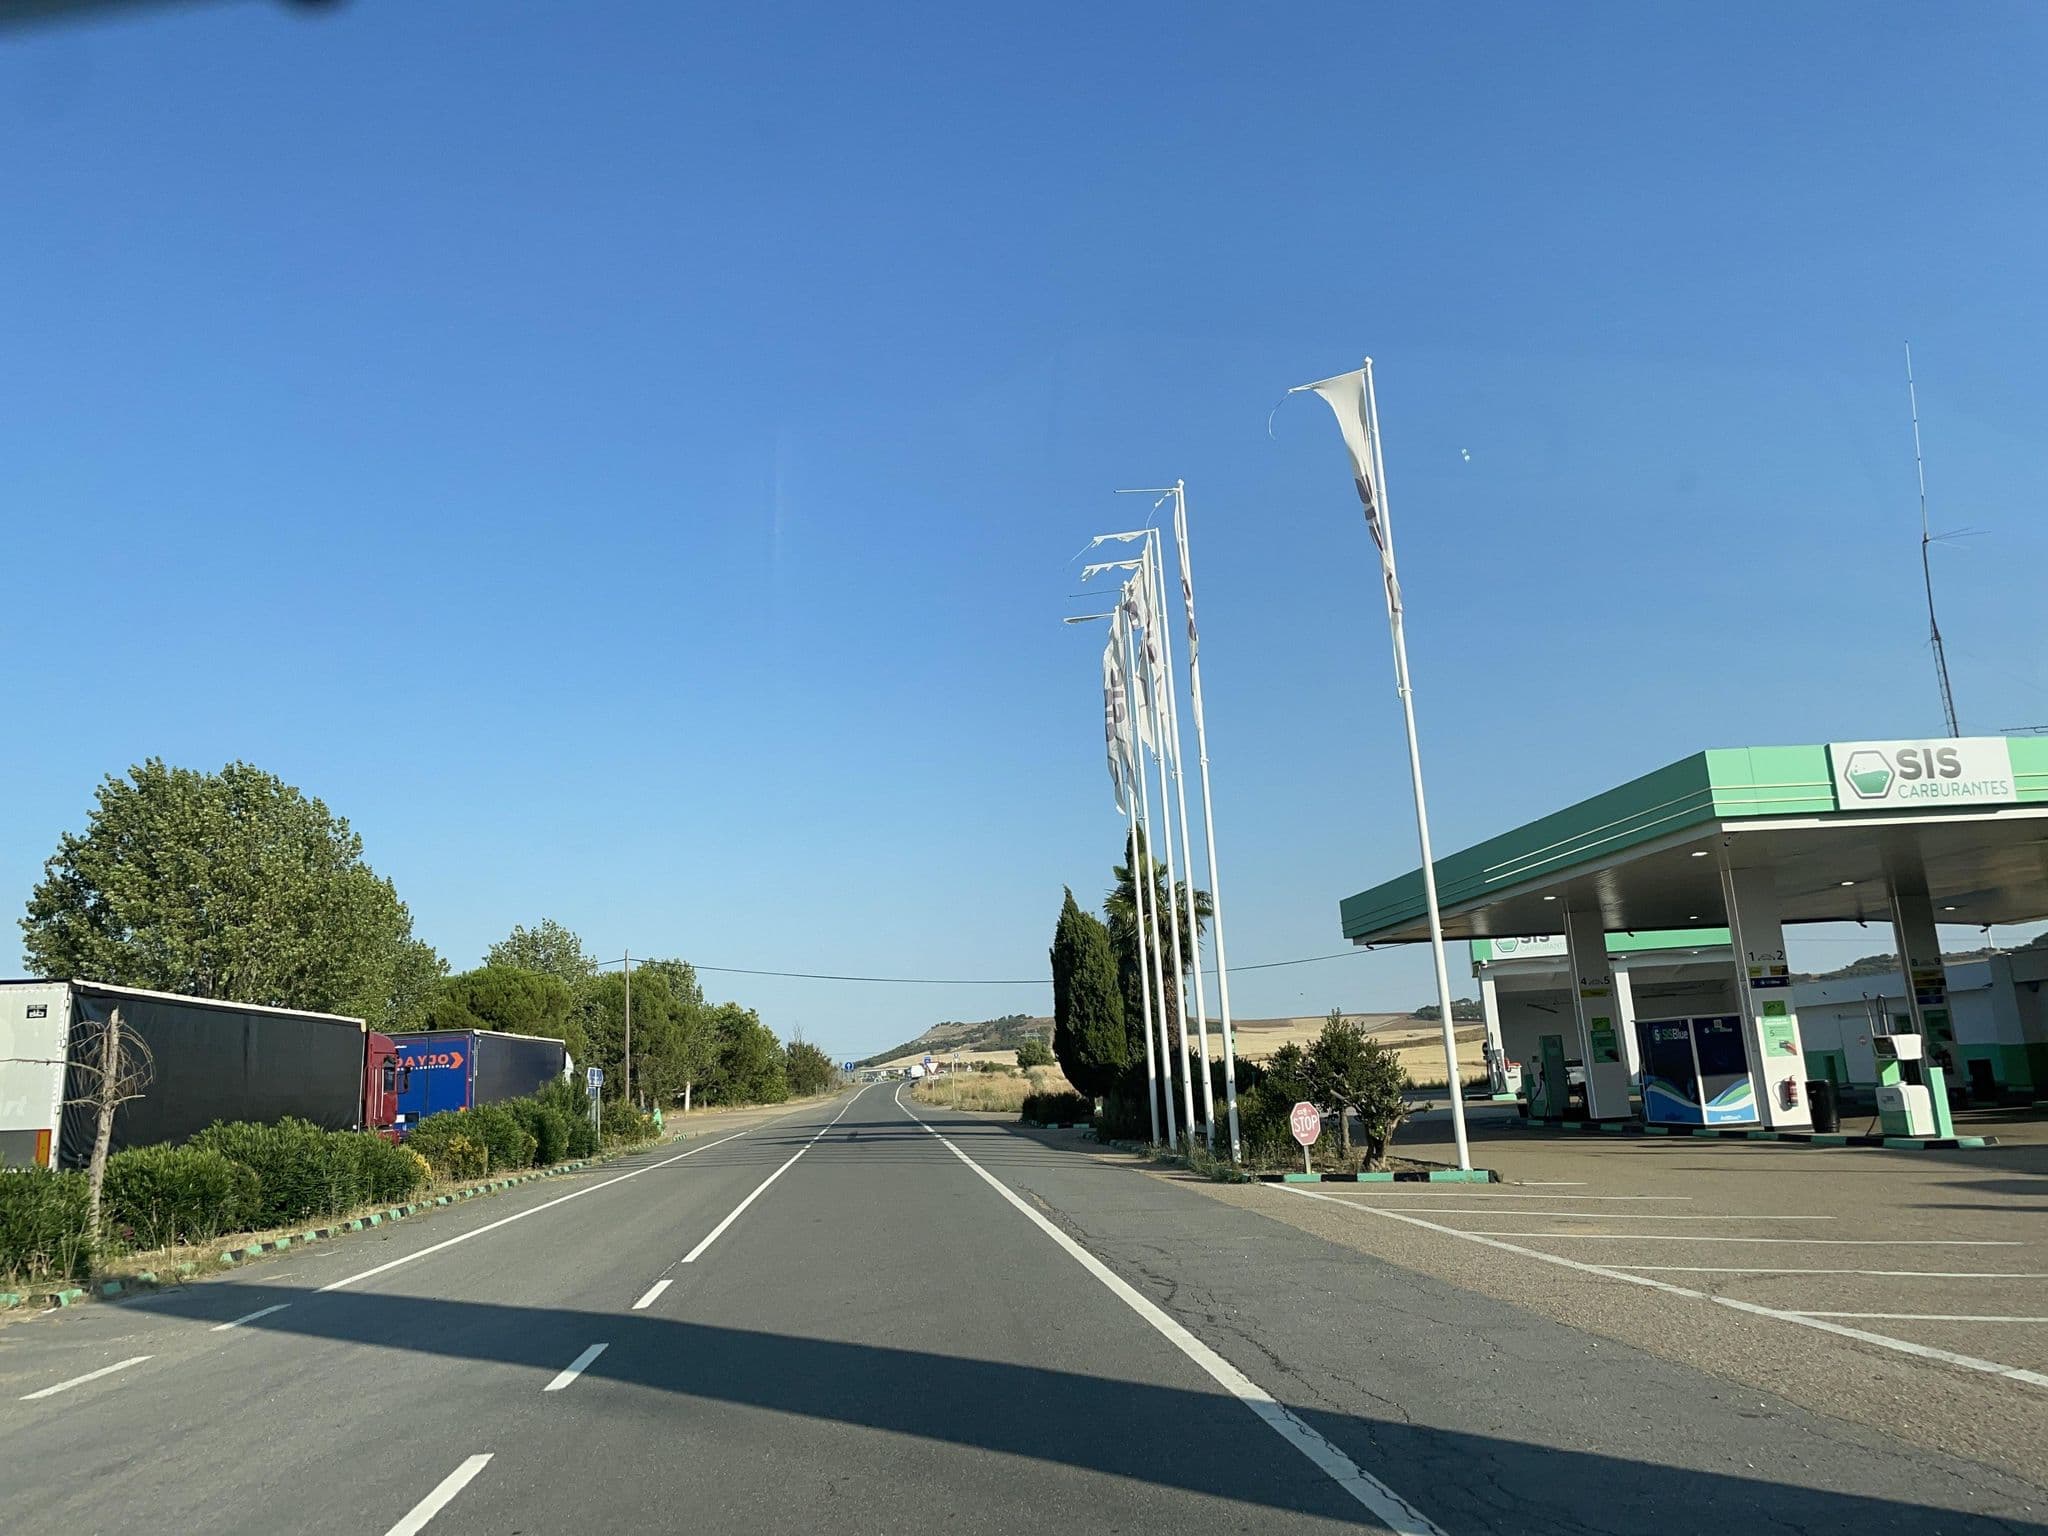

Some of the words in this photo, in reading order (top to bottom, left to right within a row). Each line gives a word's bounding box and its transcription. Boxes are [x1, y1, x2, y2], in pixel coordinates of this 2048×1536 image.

[1896, 747, 1962, 781] SIS
[1899, 780, 2009, 799] CARBURANTES
[1749, 952, 1755, 961] 1
[1776, 950, 1785, 960] 2
[1604, 976, 1610, 985] 5
[1294, 1114, 1318, 1132] STOP
